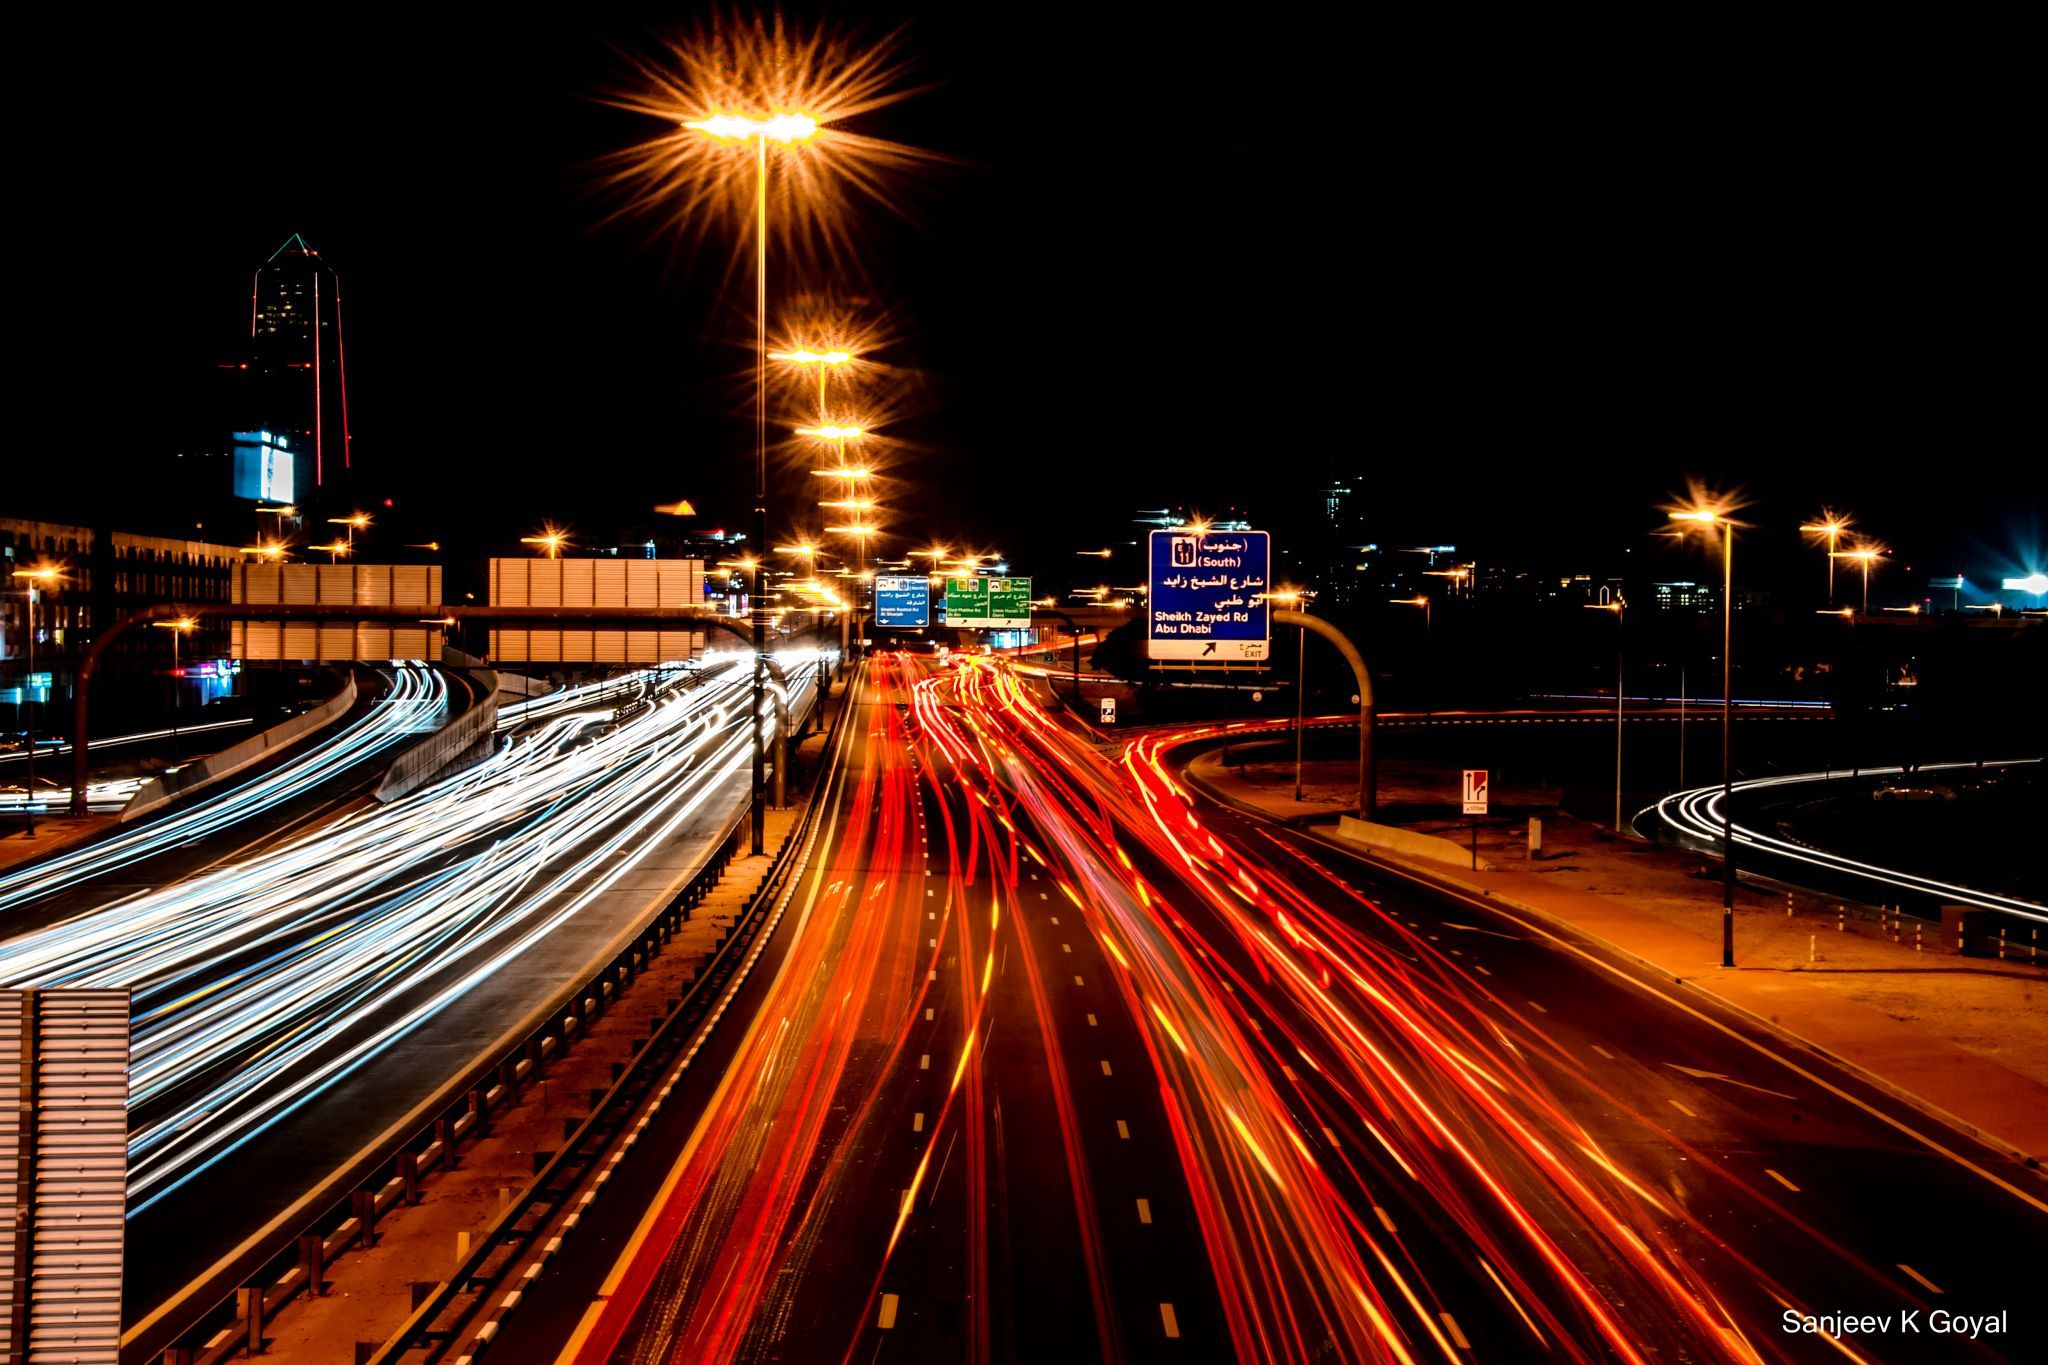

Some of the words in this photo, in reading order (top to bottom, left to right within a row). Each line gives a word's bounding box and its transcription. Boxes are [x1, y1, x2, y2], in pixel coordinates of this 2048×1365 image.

[1198, 556, 1241, 568] (South)
[1163, 574, 1188, 588] زايد
[1190, 575, 1228, 590] الشيخ
[1230, 575, 1264, 590] شارع
[1214, 594, 1244, 611] ظبي
[1155, 611, 1192, 622] Sheikh
[1196, 611, 1231, 624] Zayed
[1233, 612, 1249, 622] Rd
[1155, 623, 1177, 633] Abu
[1180, 623, 1212, 634] Dhabi
[1244, 650, 1262, 658] EXIT
